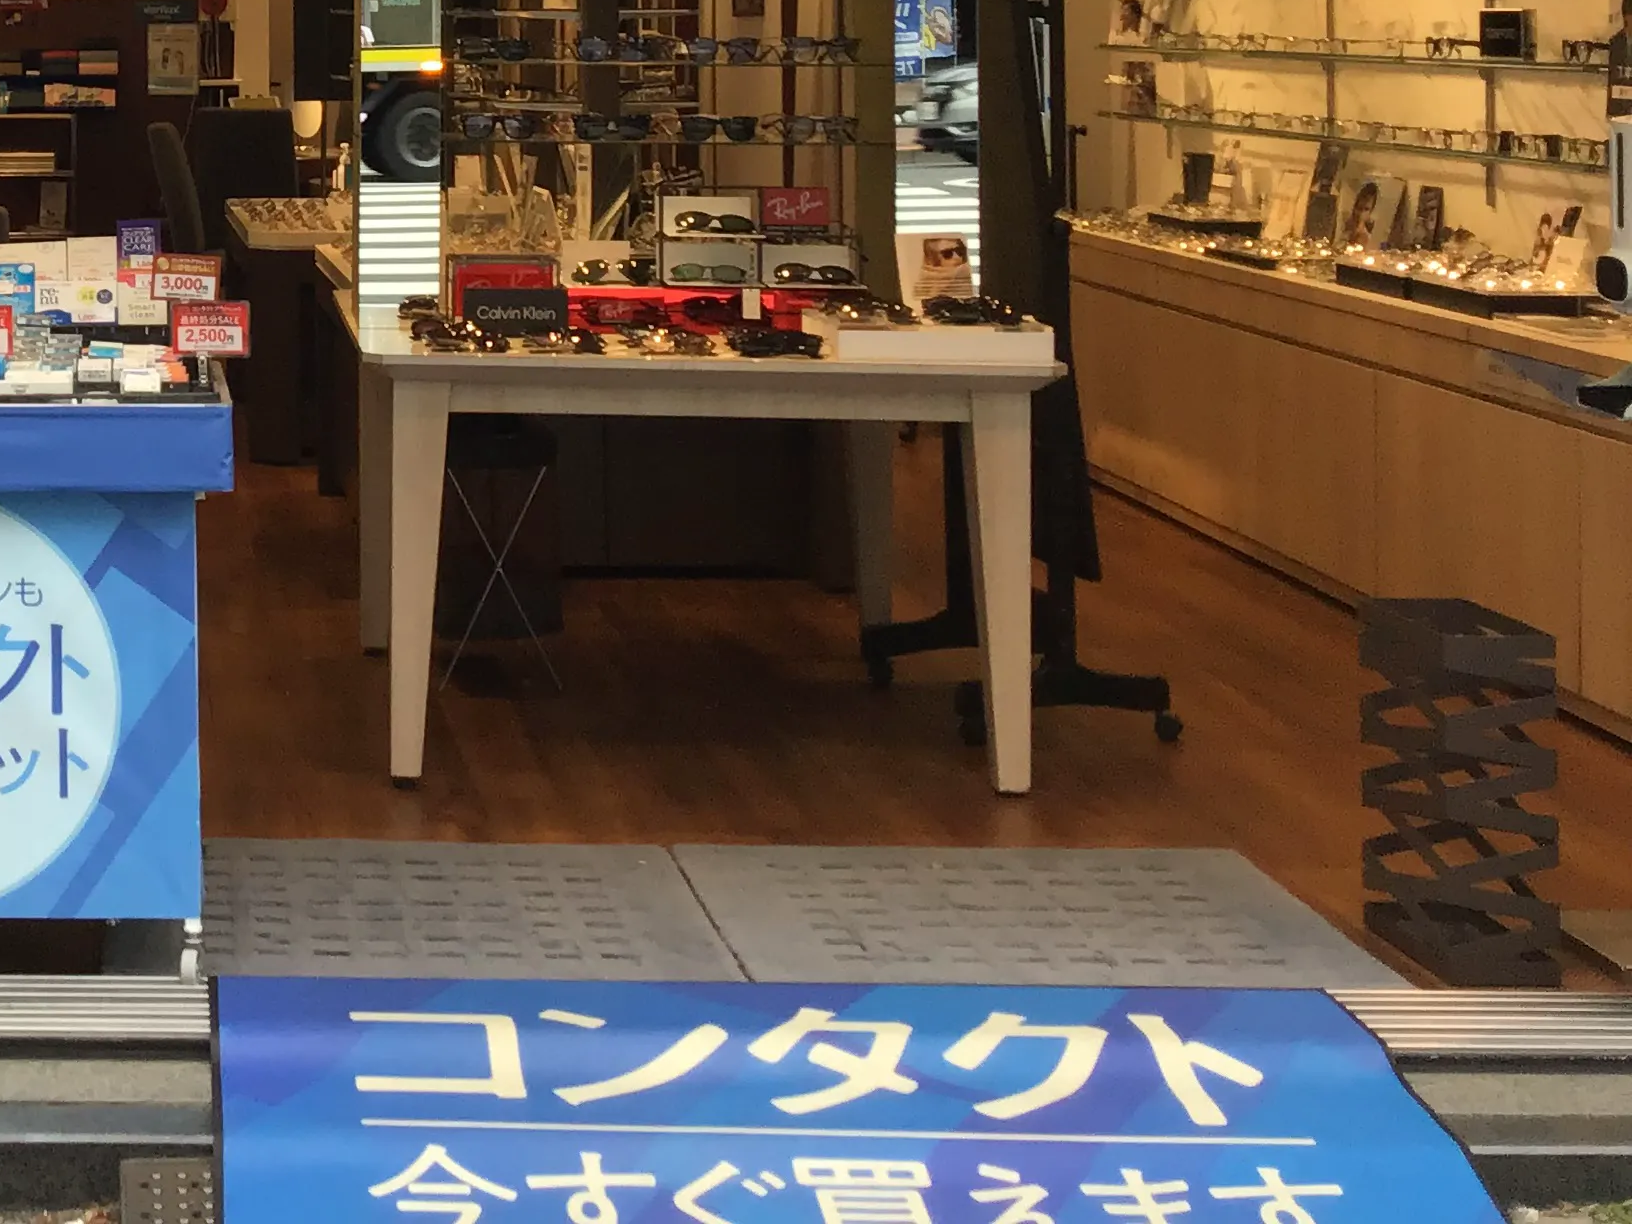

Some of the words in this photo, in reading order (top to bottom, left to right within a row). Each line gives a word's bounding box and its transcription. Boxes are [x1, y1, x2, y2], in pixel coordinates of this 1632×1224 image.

[476, 305, 520, 321] Calvin
[523, 305, 556, 321] Klein
[348, 1005, 1265, 1129] コンタクト
[366, 1141, 1345, 1224] 今すぐ買えます
